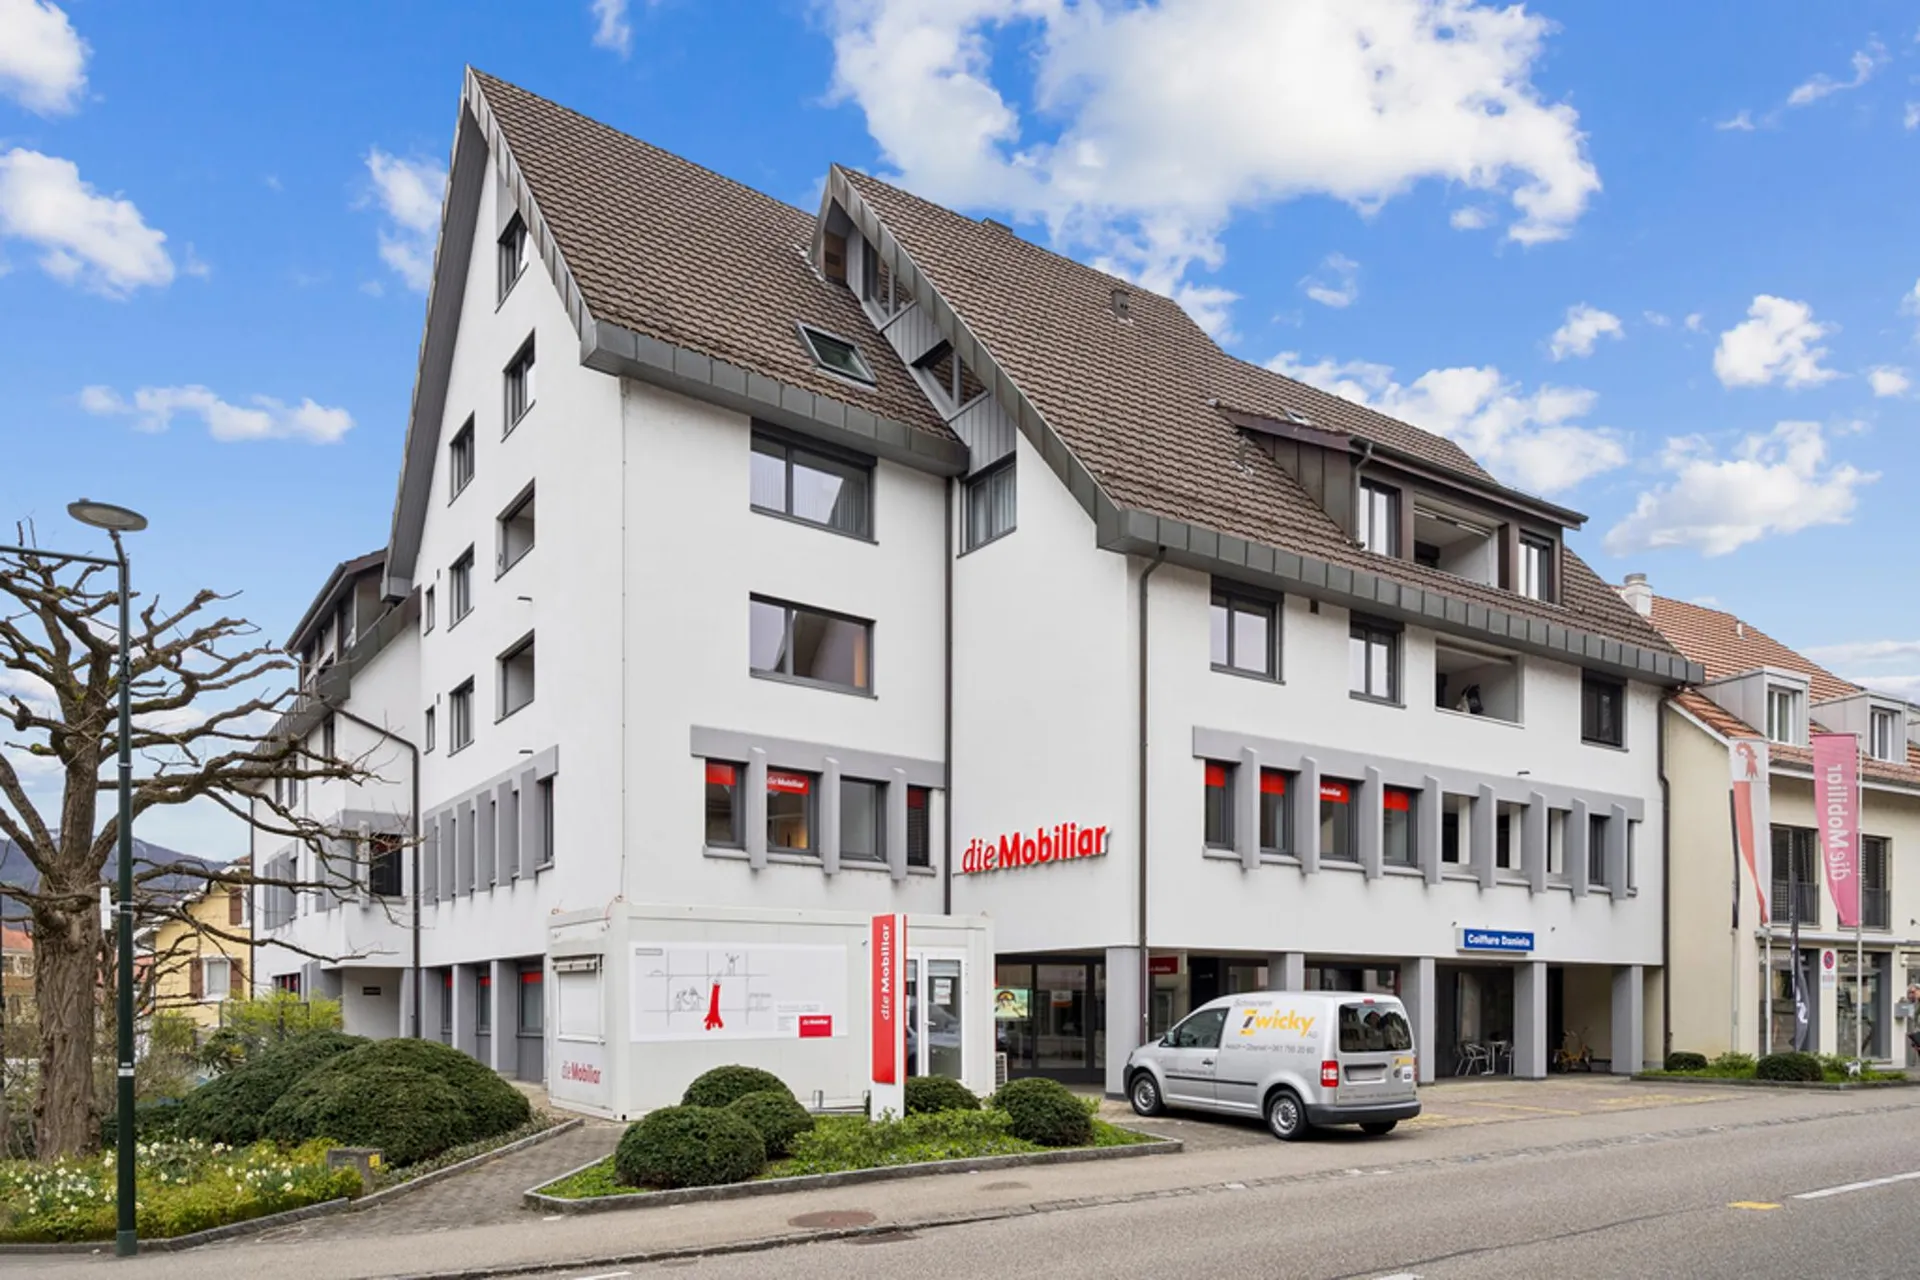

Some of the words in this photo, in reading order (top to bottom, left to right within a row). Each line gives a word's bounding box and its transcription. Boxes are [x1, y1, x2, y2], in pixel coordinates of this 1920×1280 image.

[999, 822, 1106, 868] Mobiliar
[1467, 933, 1500, 946] Coiffure
[880, 924, 890, 992] Mobiliar
[571, 1062, 601, 1085] Mobiliar
